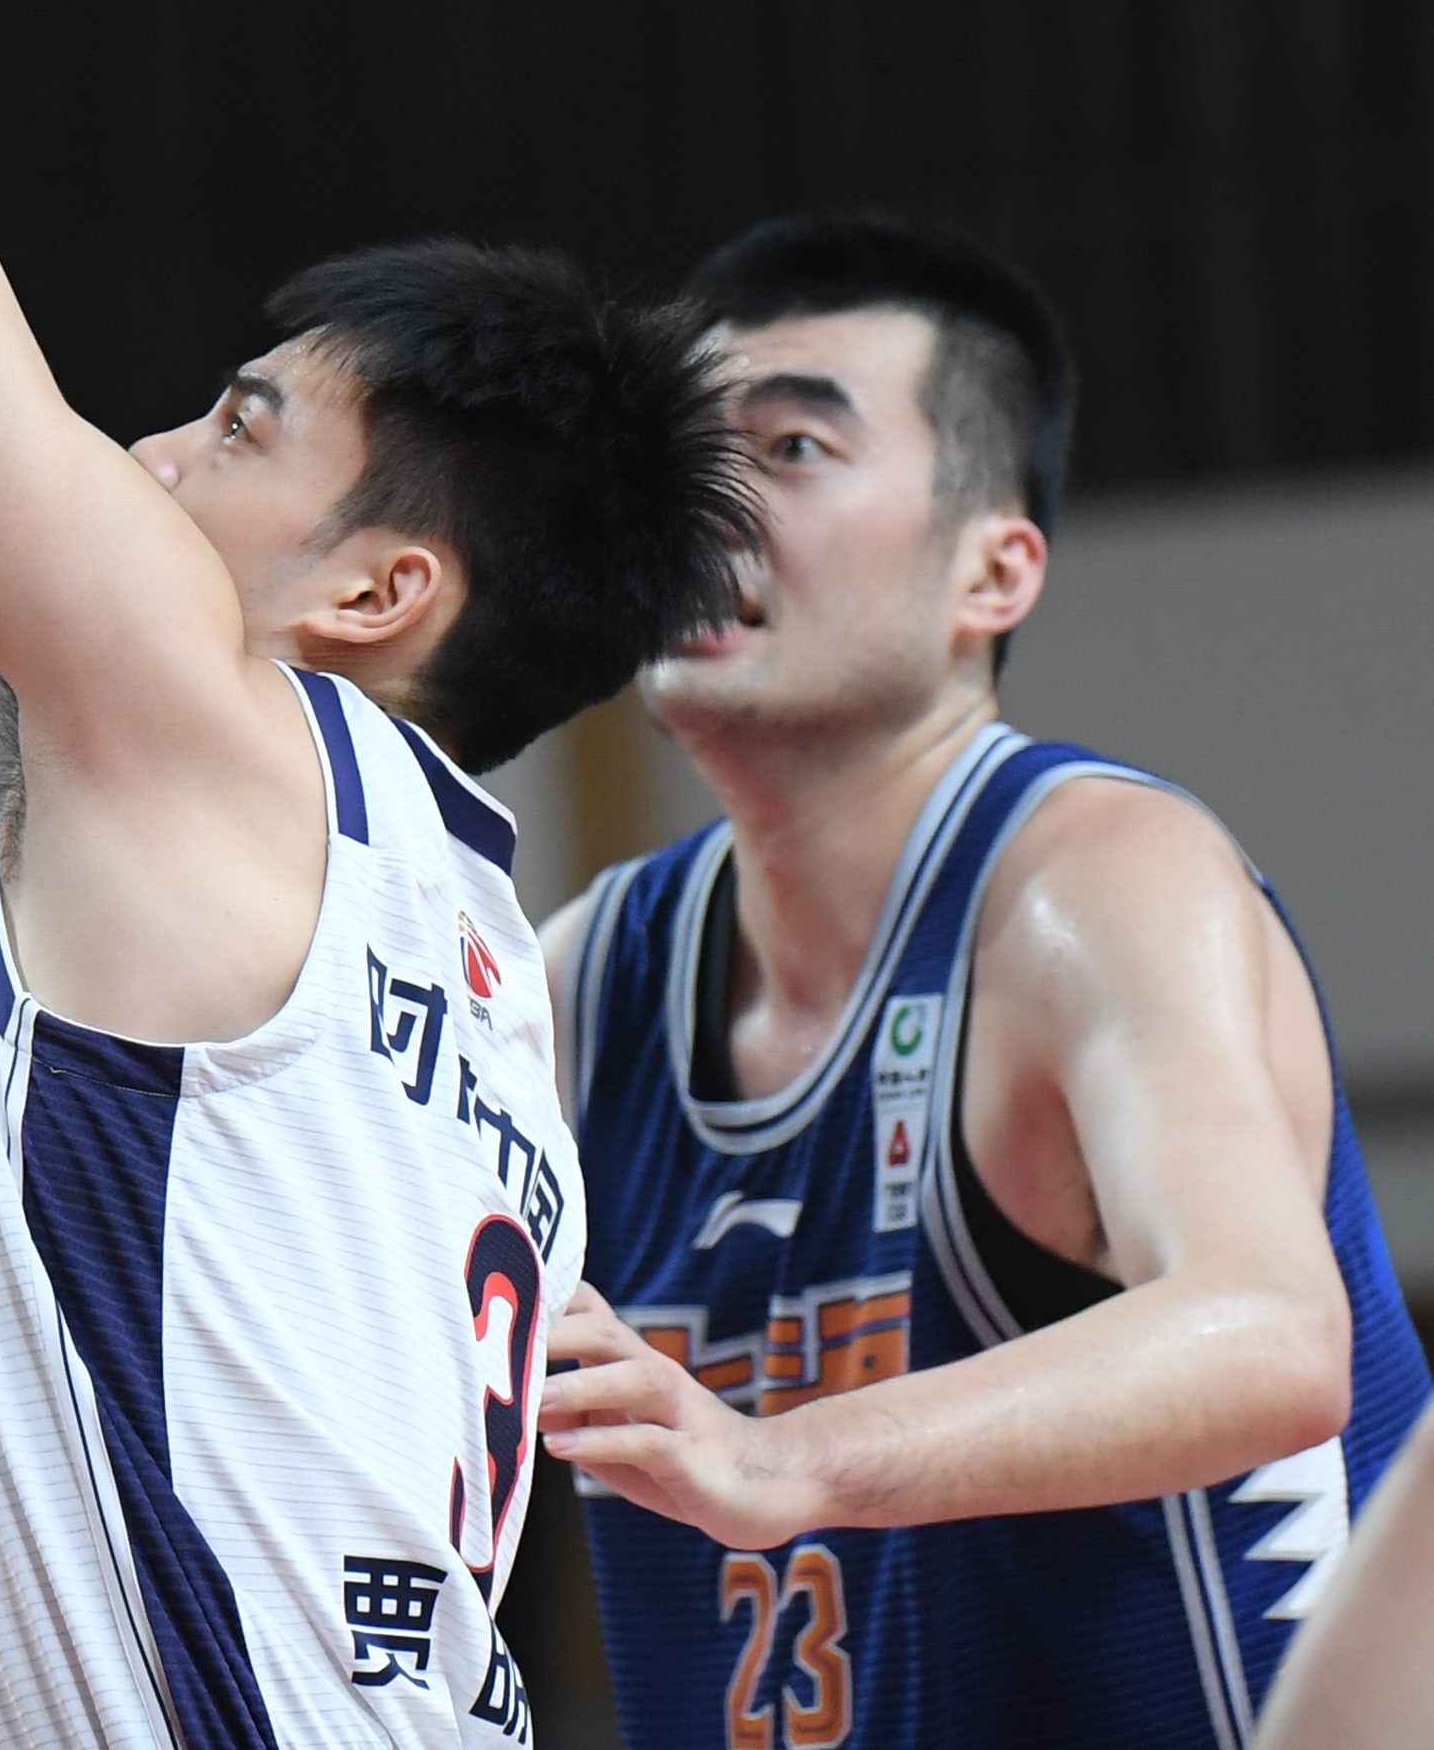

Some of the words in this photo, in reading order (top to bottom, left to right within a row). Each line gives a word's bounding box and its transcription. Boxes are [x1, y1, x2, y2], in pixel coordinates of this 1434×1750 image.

[467, 994, 494, 1031] BA
[448, 1214, 541, 1608] 3
[719, 1542, 854, 1750] 23
